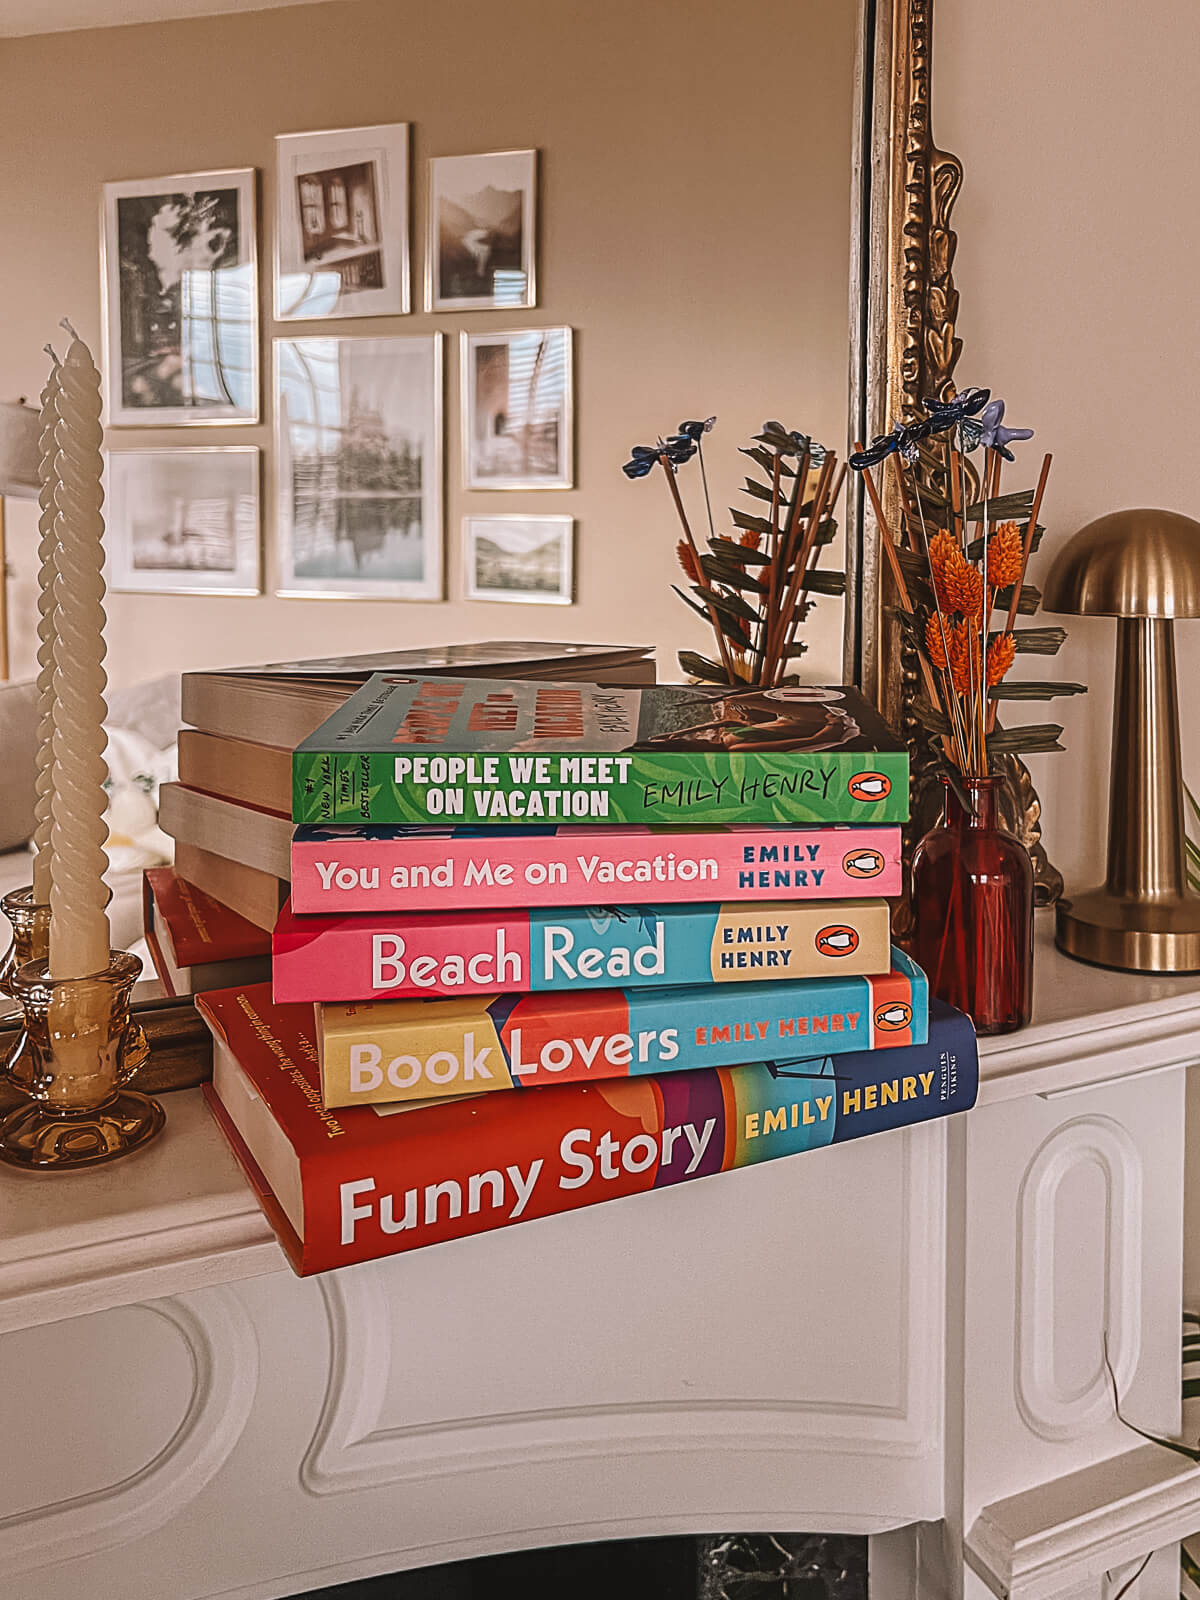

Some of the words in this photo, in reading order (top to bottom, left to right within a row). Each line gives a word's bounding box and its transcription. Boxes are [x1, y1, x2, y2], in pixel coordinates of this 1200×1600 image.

[533, 688, 585, 739] VACATION
[320, 756, 332, 786] YORK
[339, 769, 351, 804] TIMES
[394, 757, 499, 784] PEOPLE
[508, 757, 552, 784] WE
[559, 757, 633, 784] MEET
[643, 775, 729, 809] EMILY
[740, 767, 838, 804] HENRY
[426, 788, 464, 816] ON
[472, 789, 609, 817] VACATION
[315, 861, 380, 890] You
[390, 859, 454, 888] and
[463, 857, 514, 887] Me
[524, 860, 568, 885] on
[576, 853, 719, 884] Vacation
[743, 844, 821, 864] EMILY
[738, 869, 826, 889] HENRY
[723, 925, 789, 945] EMILY
[371, 928, 522, 990] Beach
[543, 921, 666, 982] Read
[720, 949, 793, 969] HENRY
[695, 1019, 770, 1046] EMILY
[778, 1011, 860, 1038] HENRY
[279, 1056, 296, 1070] The
[350, 1031, 494, 1093] Book
[510, 1027, 680, 1076] Lovers
[939, 1052, 947, 1101] PENGUIN
[949, 1055, 957, 1095] VIKING
[745, 1095, 833, 1139] EMILY
[842, 1070, 936, 1115] HENRY
[325, 1119, 346, 1138] Two
[339, 1158, 544, 1246] Funny
[558, 1117, 717, 1190] Story
